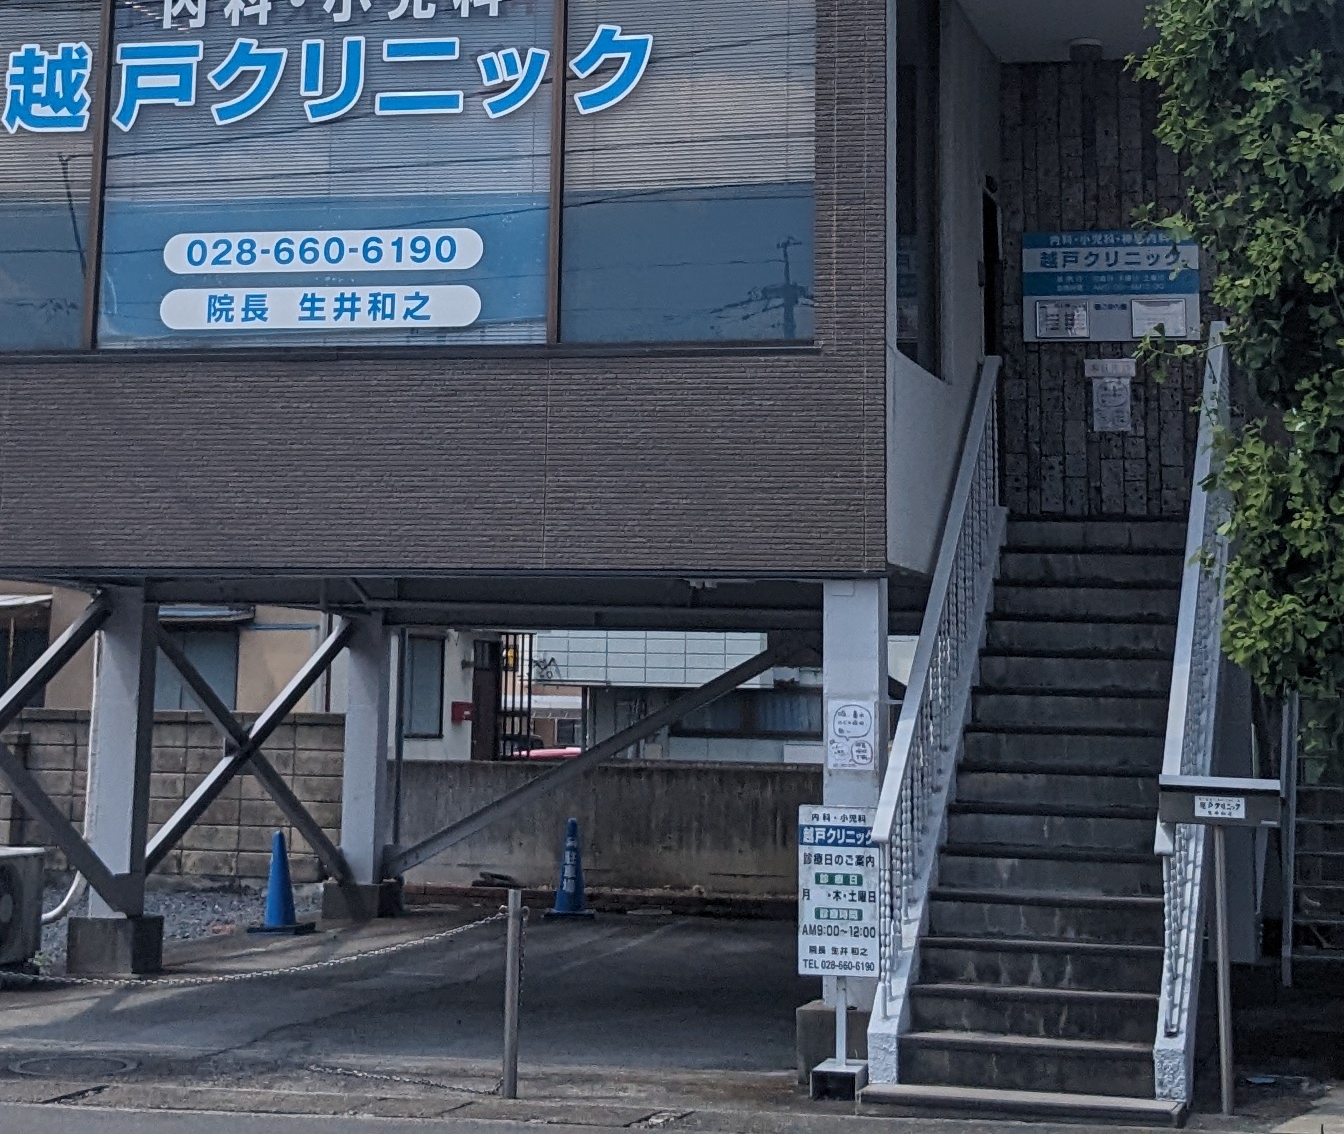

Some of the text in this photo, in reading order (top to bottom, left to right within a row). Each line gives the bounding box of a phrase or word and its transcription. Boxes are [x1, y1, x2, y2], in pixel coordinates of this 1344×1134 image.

[1, 23, 655, 134] 越戸クリニック
[186, 234, 458, 267] 028-660-6190
[205, 291, 432, 324] 院長 生井和之
